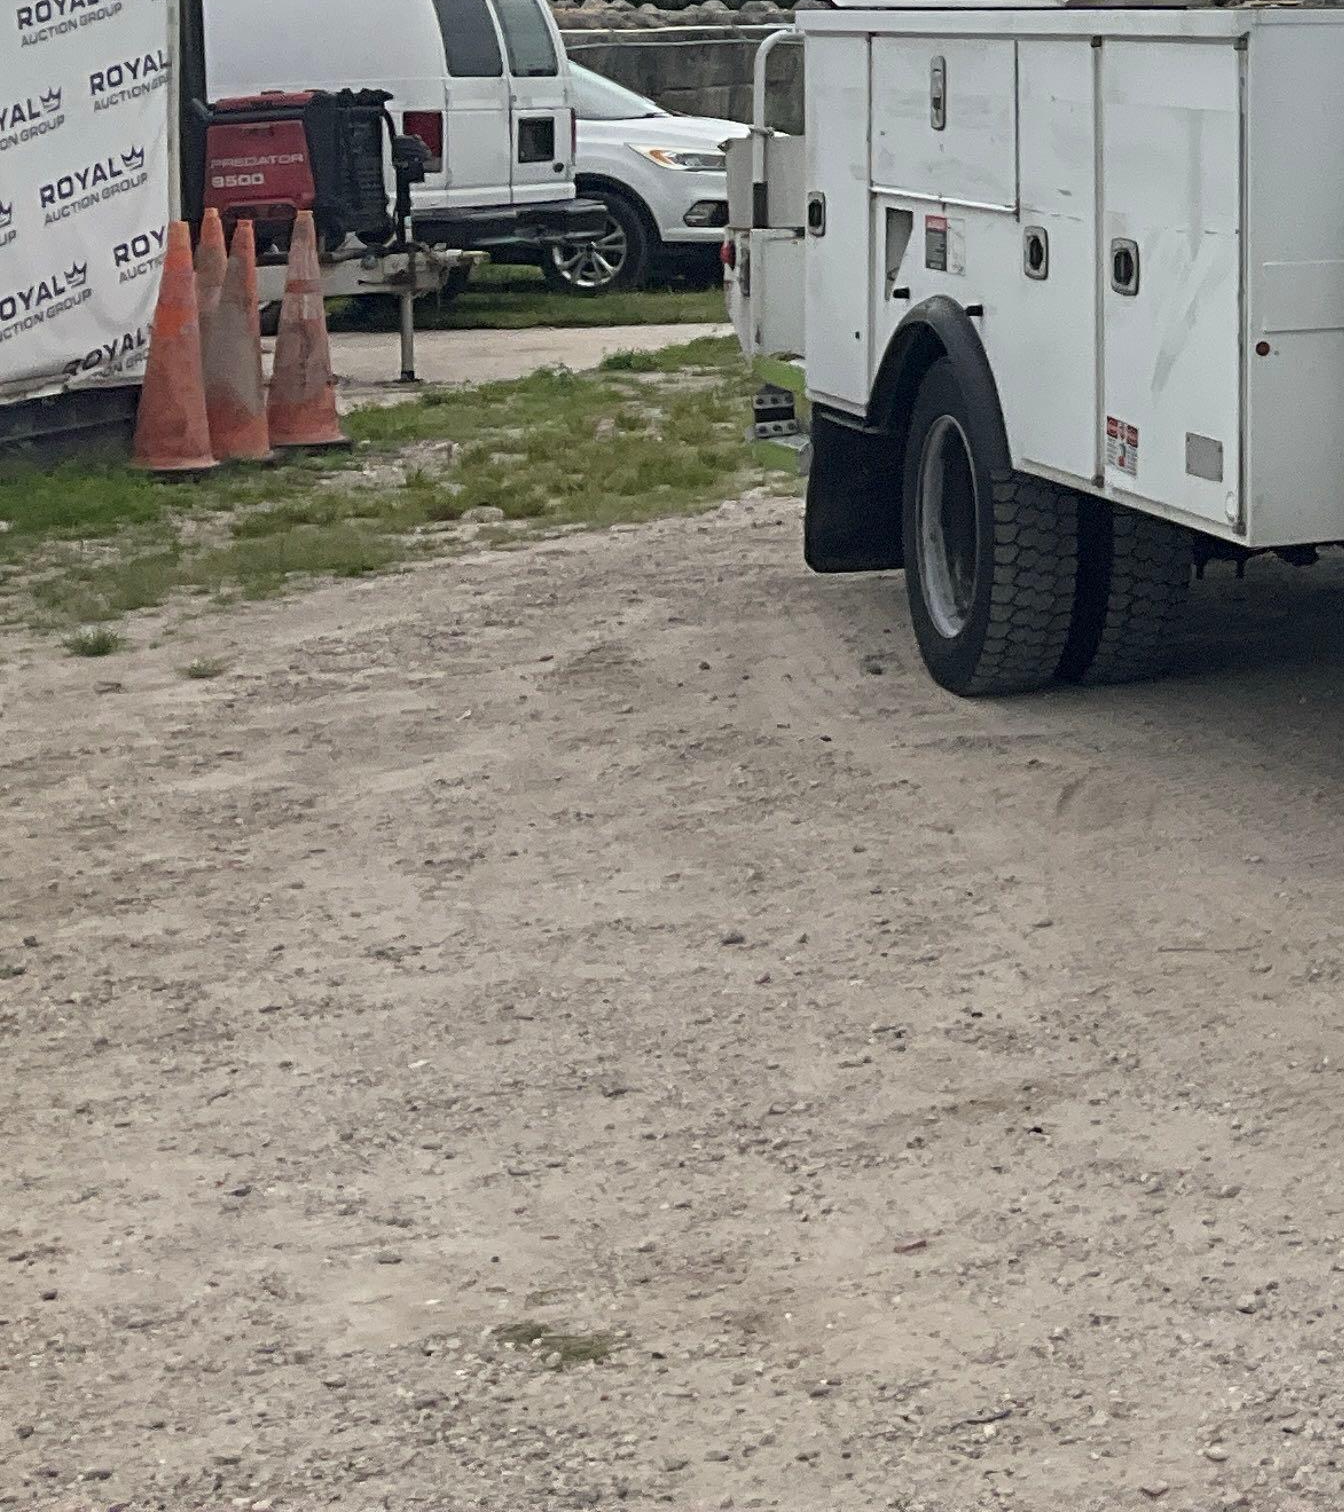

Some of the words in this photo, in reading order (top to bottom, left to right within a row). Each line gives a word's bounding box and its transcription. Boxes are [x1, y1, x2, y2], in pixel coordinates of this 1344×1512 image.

[21, 19, 78, 47] AUCTION
[79, 2, 122, 26] GROUP
[89, 50, 172, 96] ROYAL
[93, 83, 150, 112] AUCTION
[20, 114, 64, 142] GROUP
[39, 157, 123, 208] ROYAL
[211, 153, 304, 168] PREDATOR
[44, 191, 100, 226] AUCTION
[101, 172, 148, 199] GROUP
[0, 274, 65, 321] OYAL
[46, 288, 93, 319] GROUP
